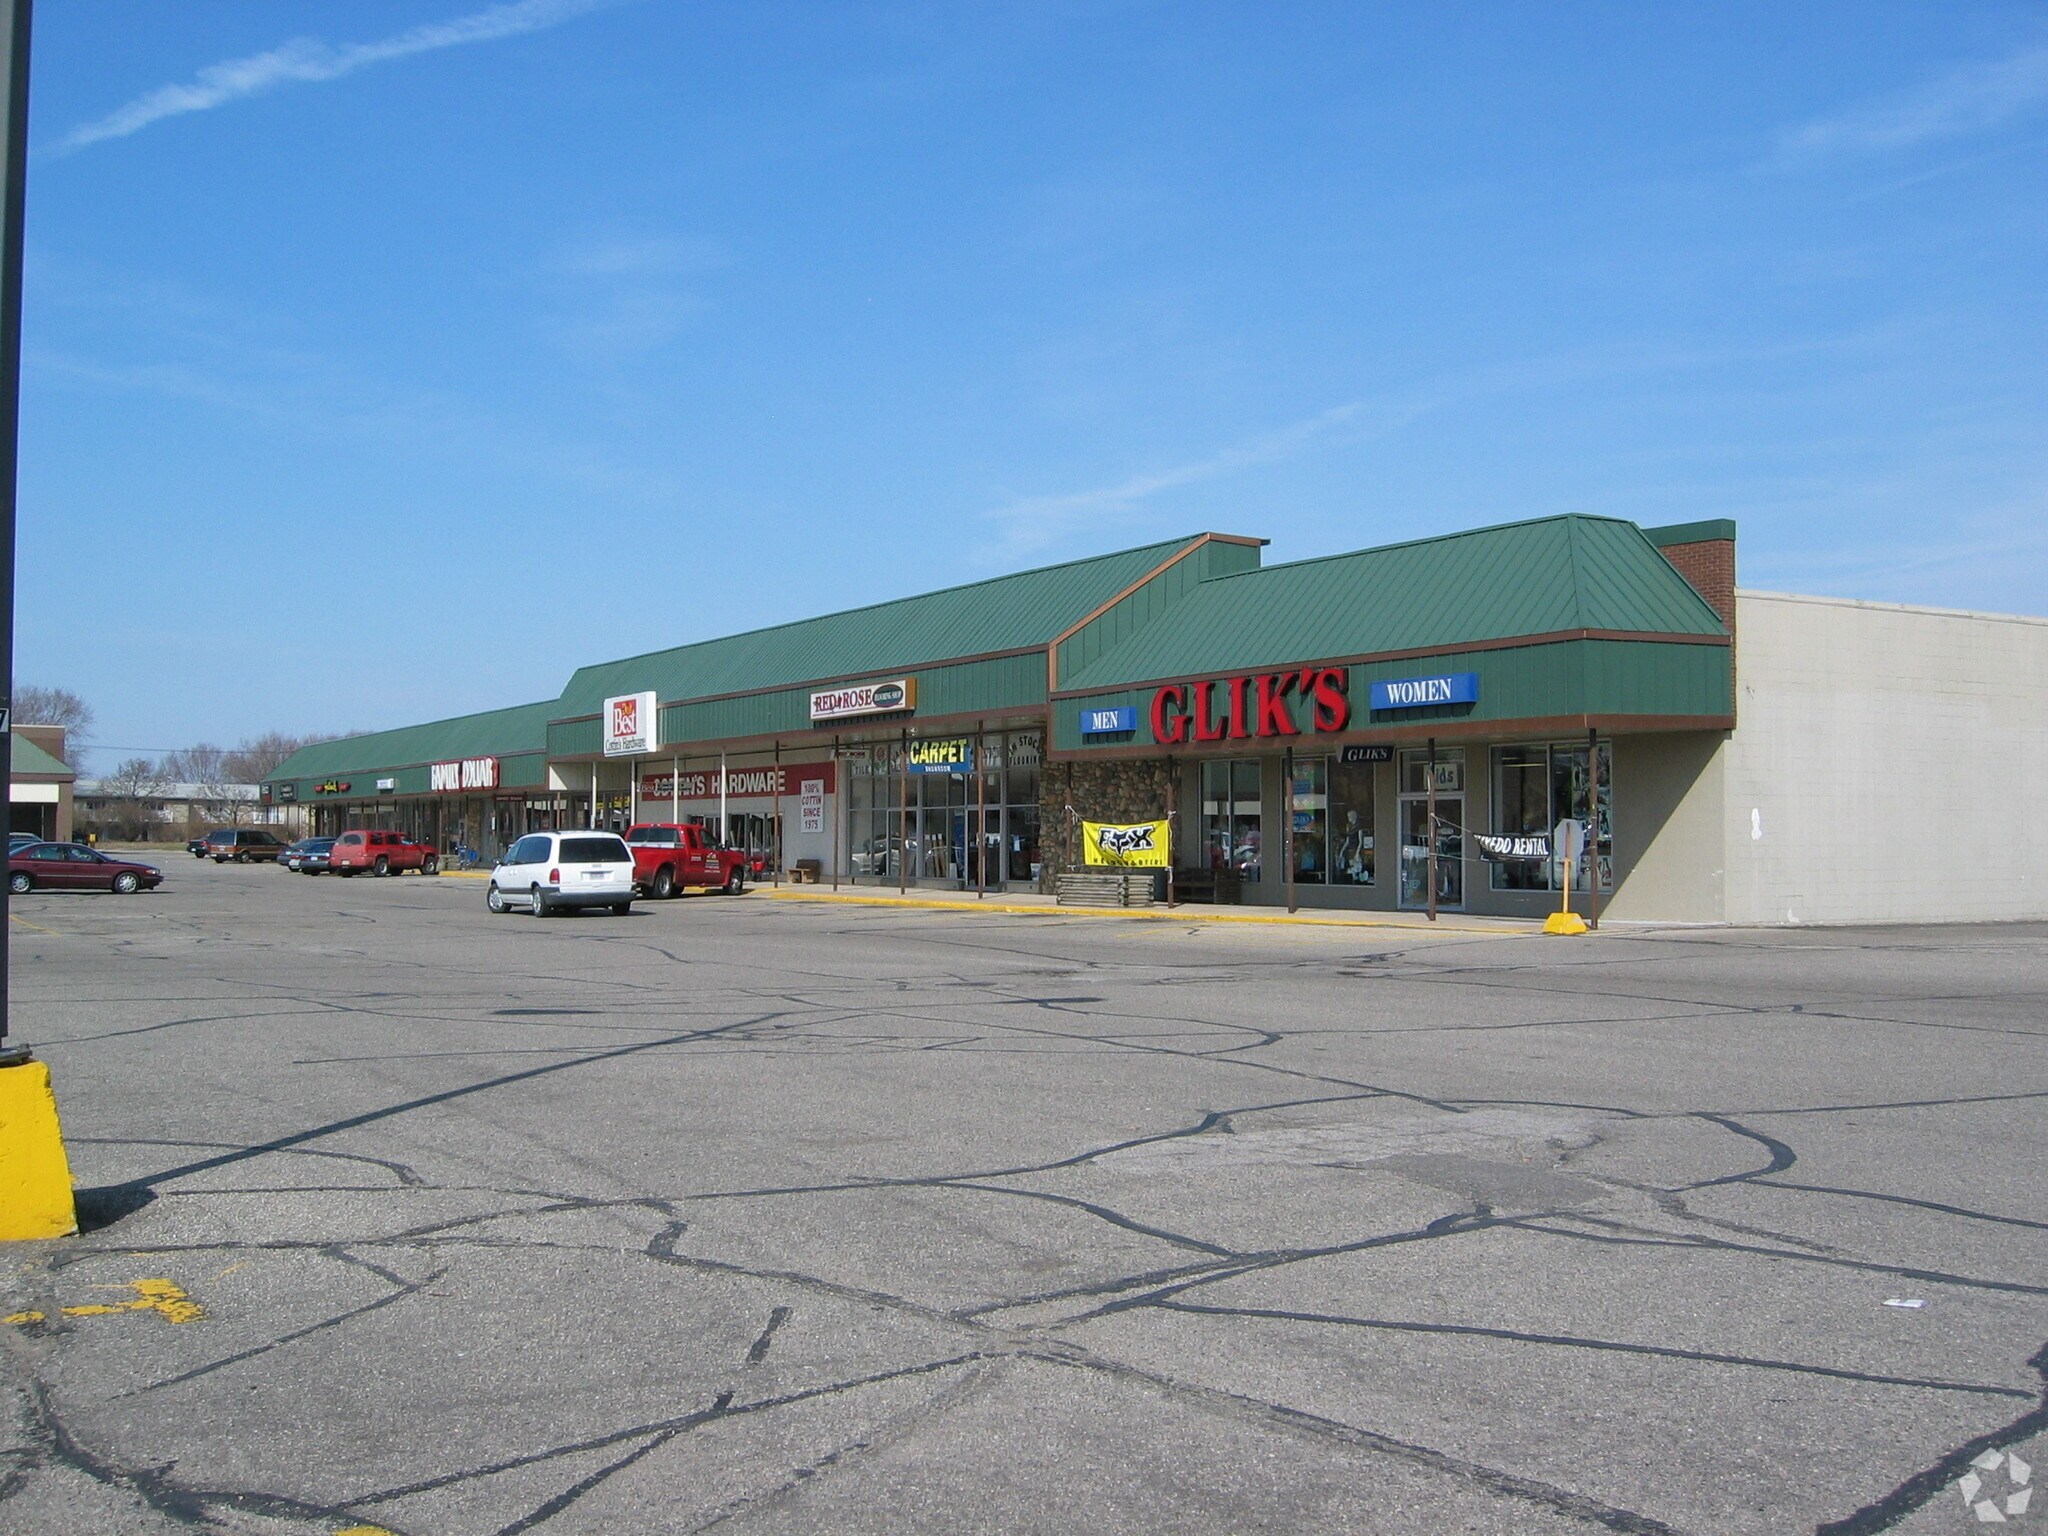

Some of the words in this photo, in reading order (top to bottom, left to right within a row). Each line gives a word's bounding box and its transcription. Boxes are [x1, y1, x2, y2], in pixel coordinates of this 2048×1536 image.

[814, 693, 838, 712] RED
[842, 689, 872, 708] ROSE
[1387, 679, 1452, 704] WOMEN
[1151, 666, 1349, 744] GLIK'S
[614, 708, 636, 735] Best
[1092, 711, 1118, 729] MEN
[909, 739, 967, 765] CARPET
[1347, 748, 1388, 761] GLIK'S
[431, 763, 460, 790] FAMILY
[802, 796, 822, 805] COTTIN
[803, 807, 821, 817] SINCE
[1473, 834, 1512, 854] XEDO
[1512, 837, 1549, 855] RENTAL
